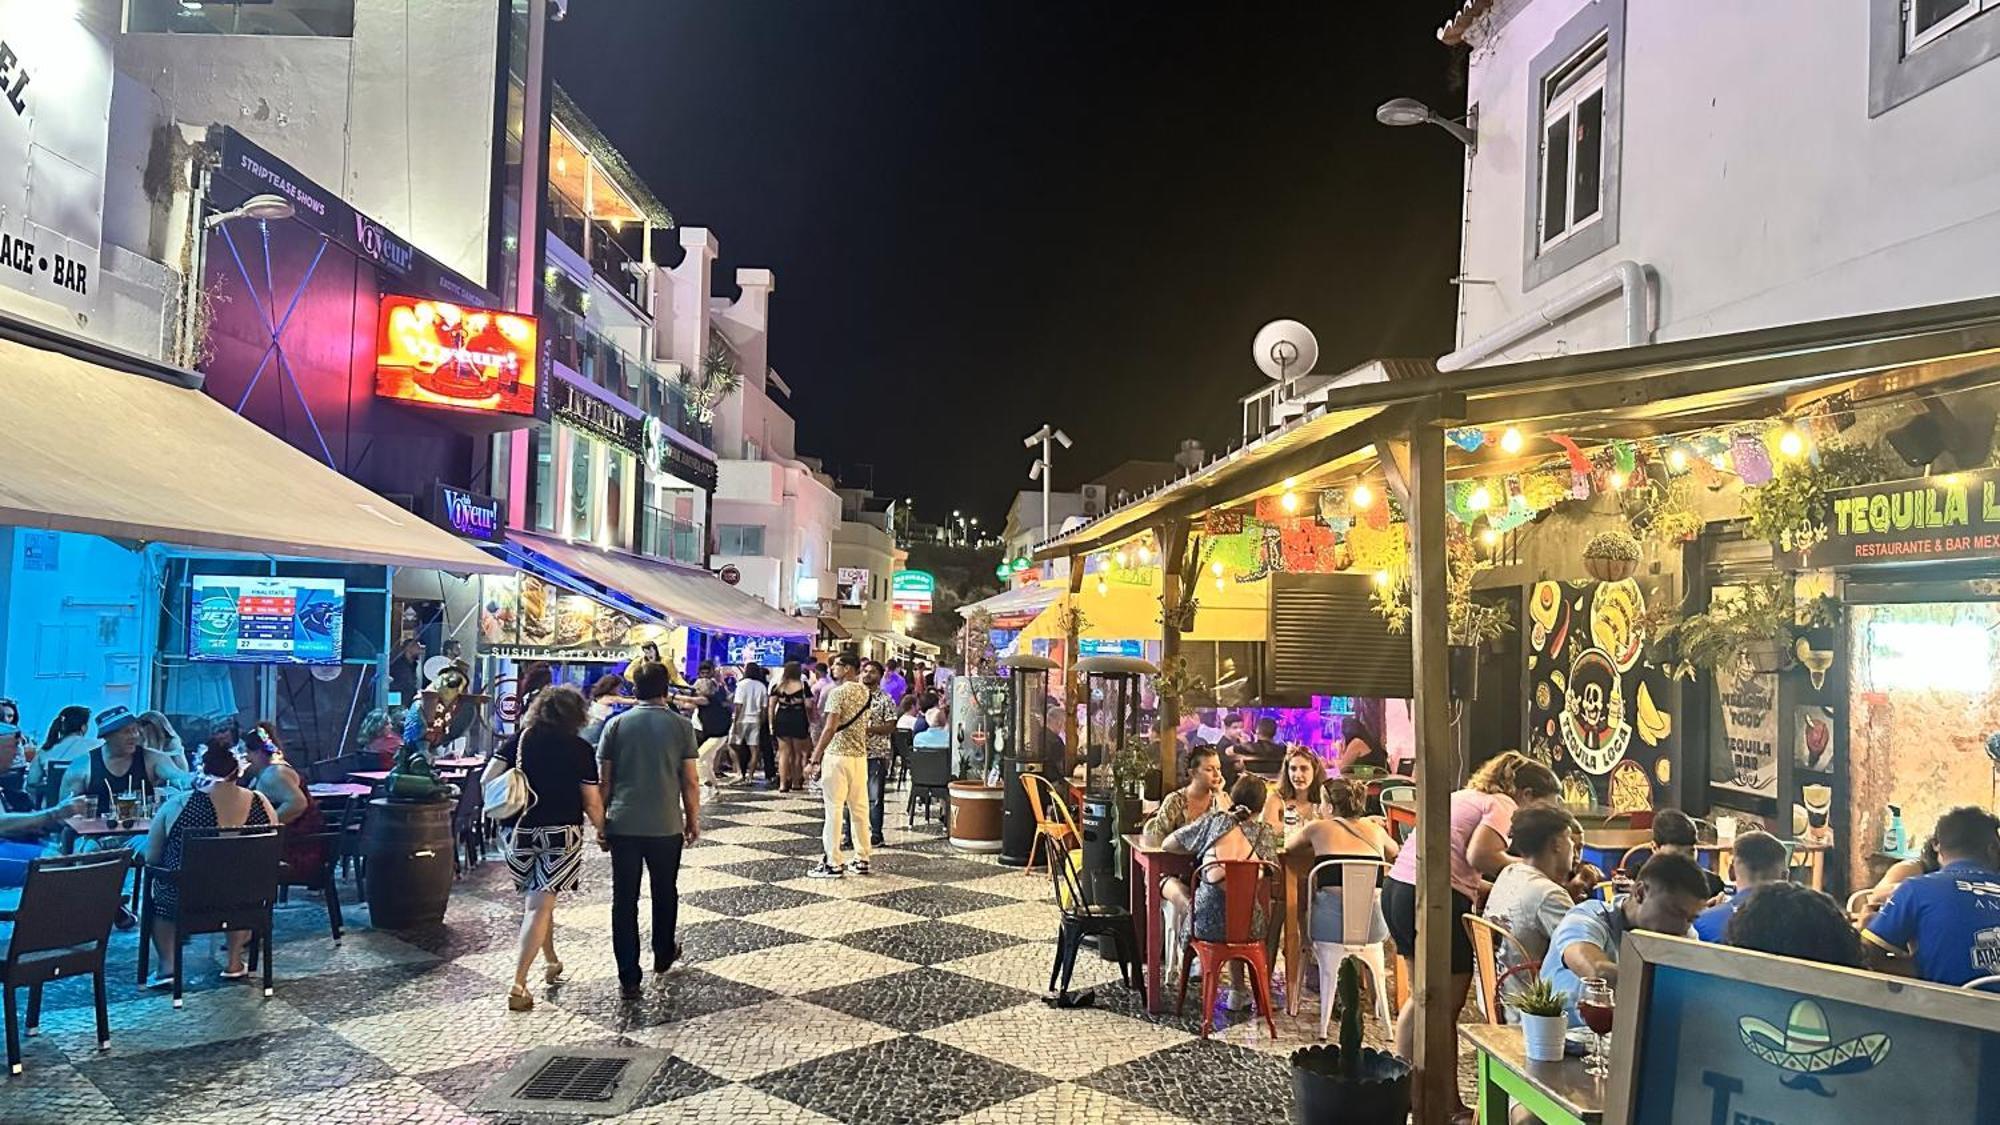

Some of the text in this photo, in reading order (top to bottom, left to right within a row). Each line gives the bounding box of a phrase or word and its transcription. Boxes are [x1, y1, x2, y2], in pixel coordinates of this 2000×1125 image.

[240, 155, 326, 216] STRIPTEASE SHOWS
[53, 254, 87, 295] BAR
[1834, 487, 1968, 535] TEQUILA
[1855, 539, 1932, 557] RESTAURANTE
[1934, 539, 1943, 552] &
[1946, 536, 1970, 552] BAR
[491, 647, 538, 658] SUSHI
[1562, 715, 1629, 770] TEQUILA LOCA
